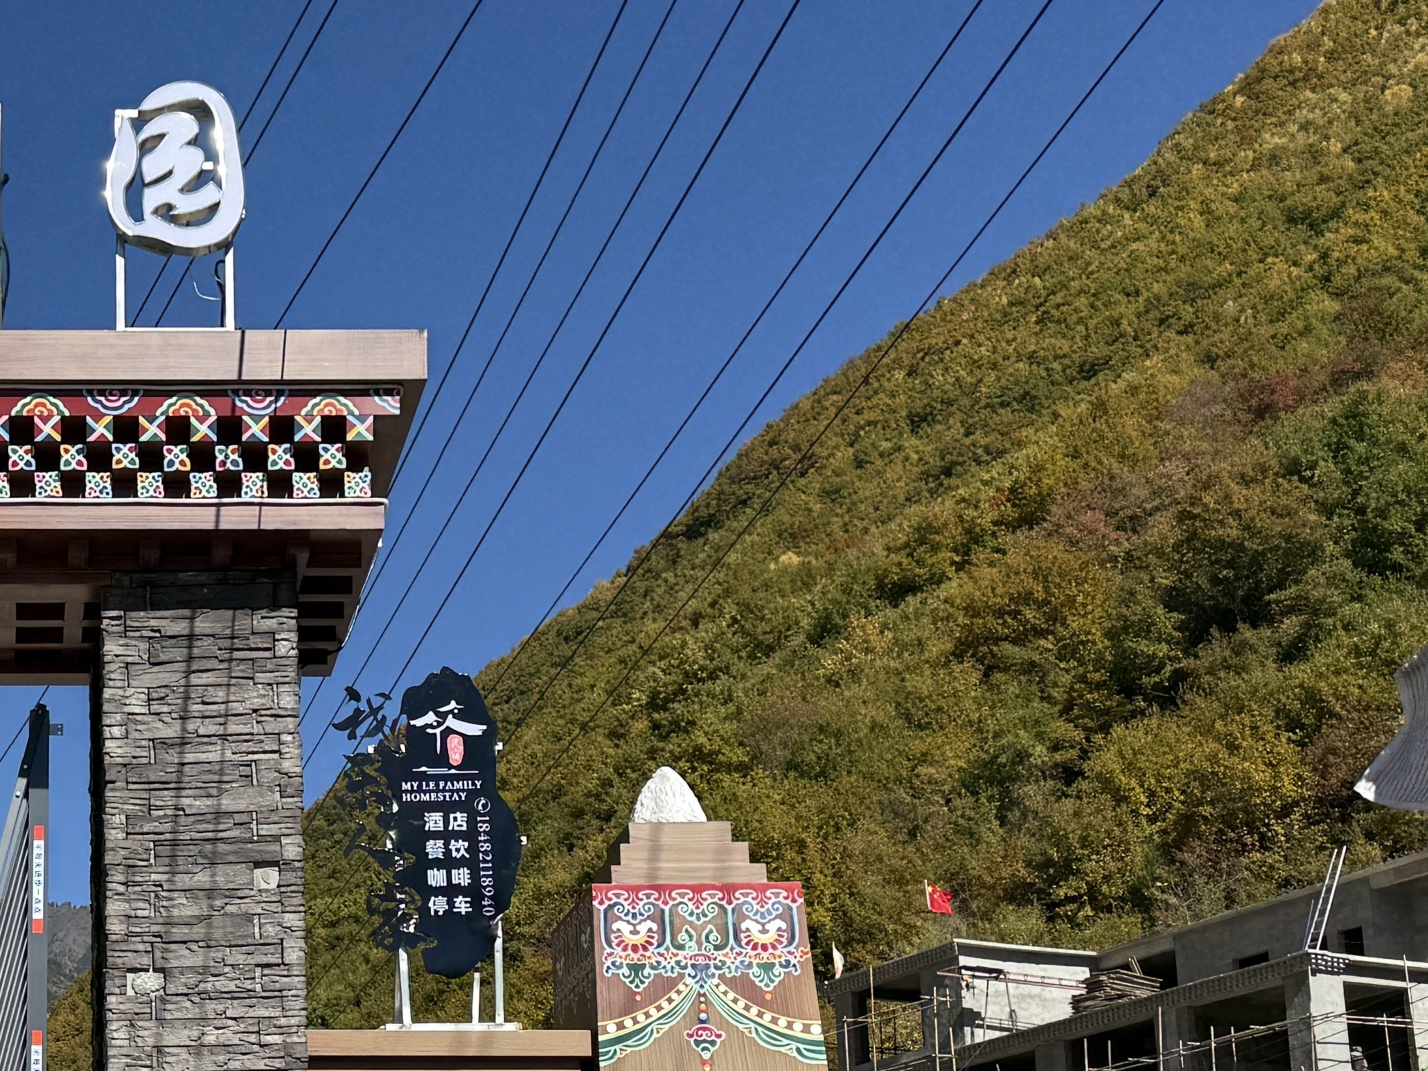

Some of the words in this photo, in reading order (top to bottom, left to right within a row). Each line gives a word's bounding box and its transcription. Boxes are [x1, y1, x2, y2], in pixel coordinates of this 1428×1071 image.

[401, 781, 419, 791] MY
[422, 781, 437, 790] LE
[439, 780, 482, 790] FAMILY
[402, 792, 467, 802] HOMESTAY
[423, 811, 468, 831] 酒店
[425, 839, 470, 859] 餐饮
[476, 816, 496, 916] 18482118940
[426, 867, 472, 888] 咖啡
[427, 895, 473, 916] 停车
